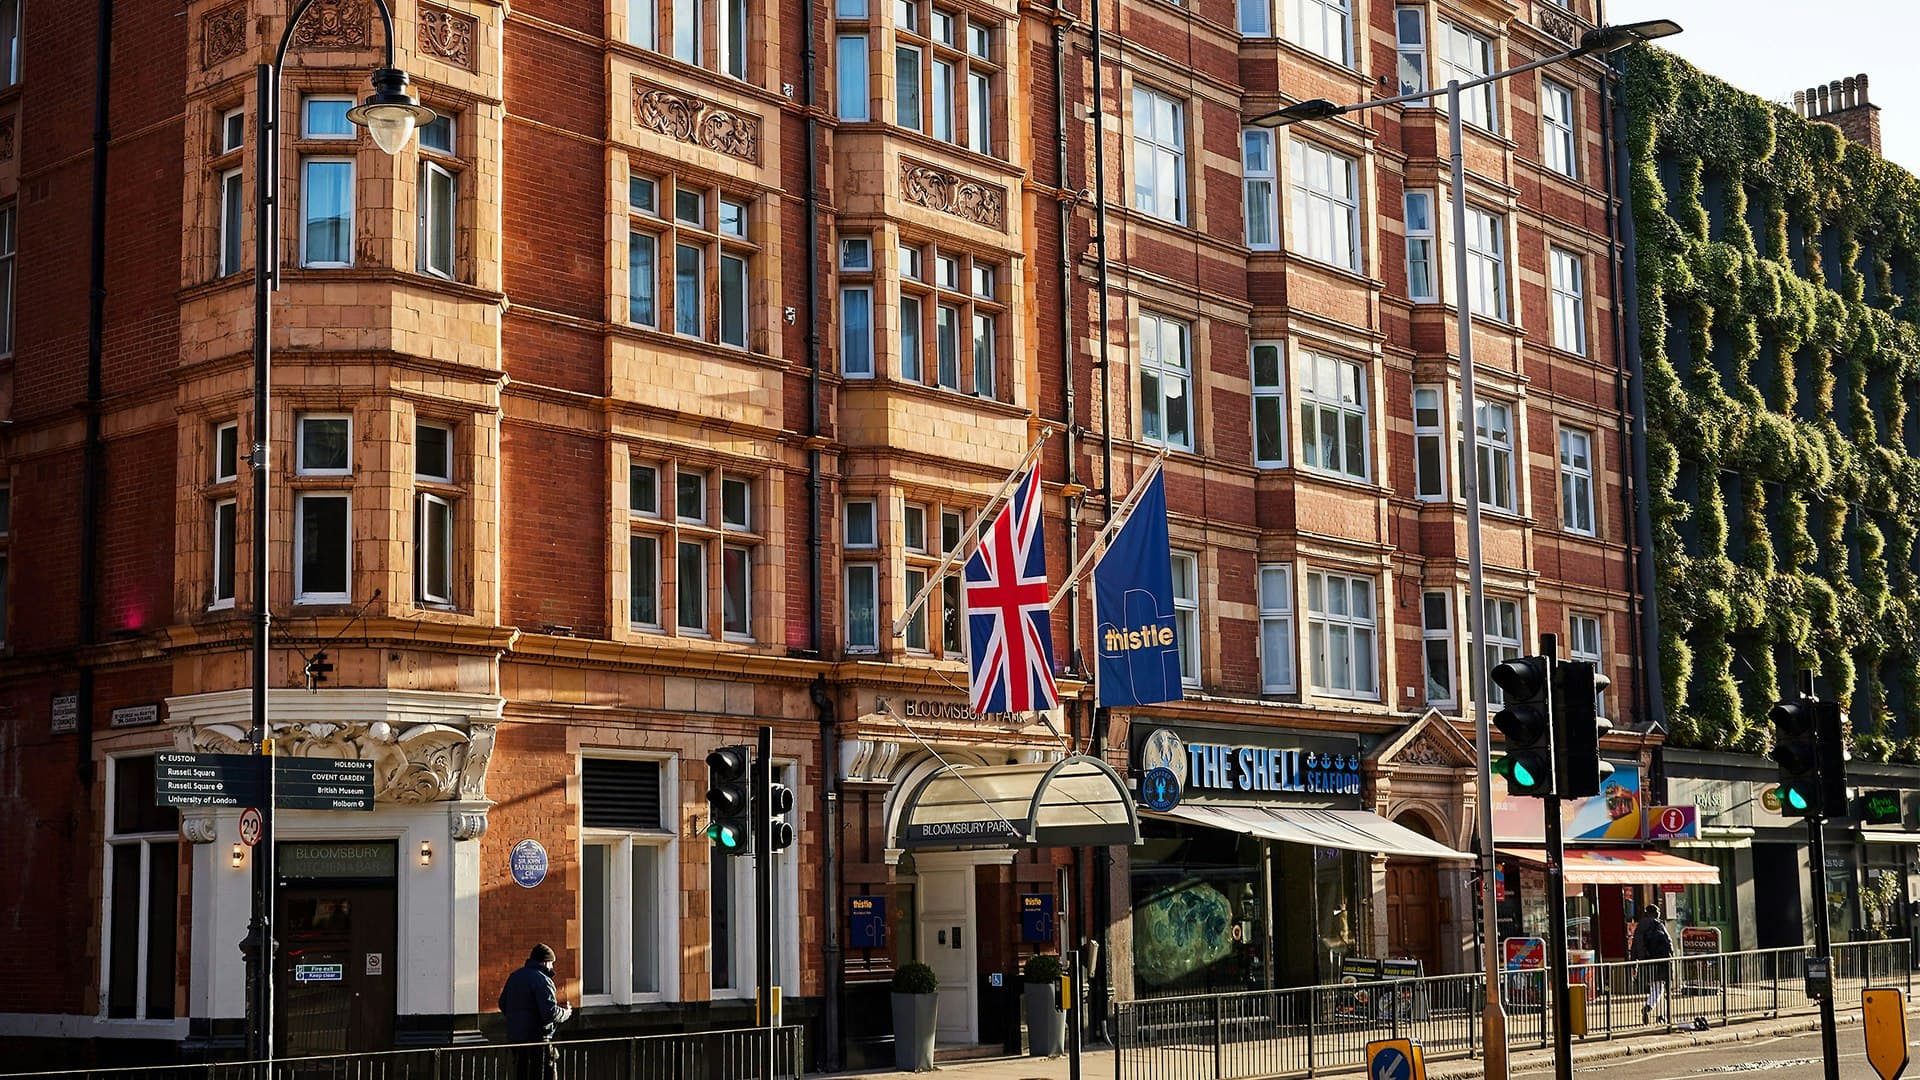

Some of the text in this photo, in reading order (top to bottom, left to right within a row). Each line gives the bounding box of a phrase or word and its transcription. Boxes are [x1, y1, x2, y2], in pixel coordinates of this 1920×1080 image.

[1105, 624, 1174, 651] thistle
[168, 754, 196, 762] EUSTON
[334, 761, 365, 769] HOLBORN
[1188, 743, 1305, 792] THE SHELL
[167, 767, 215, 778] Russell Square
[311, 773, 365, 782] COVENT GARDEN
[168, 781, 216, 791] Russell Square
[1307, 771, 1359, 795] SEAFOOD
[317, 786, 364, 795] British Museum
[168, 795, 202, 805] University
[212, 796, 237, 804] London
[332, 800, 358, 808] Holborn
[242, 818, 259, 835] 20
[922, 822, 986, 836] BLOOMSBURY
[296, 847, 380, 859] BLOOMSBURY
